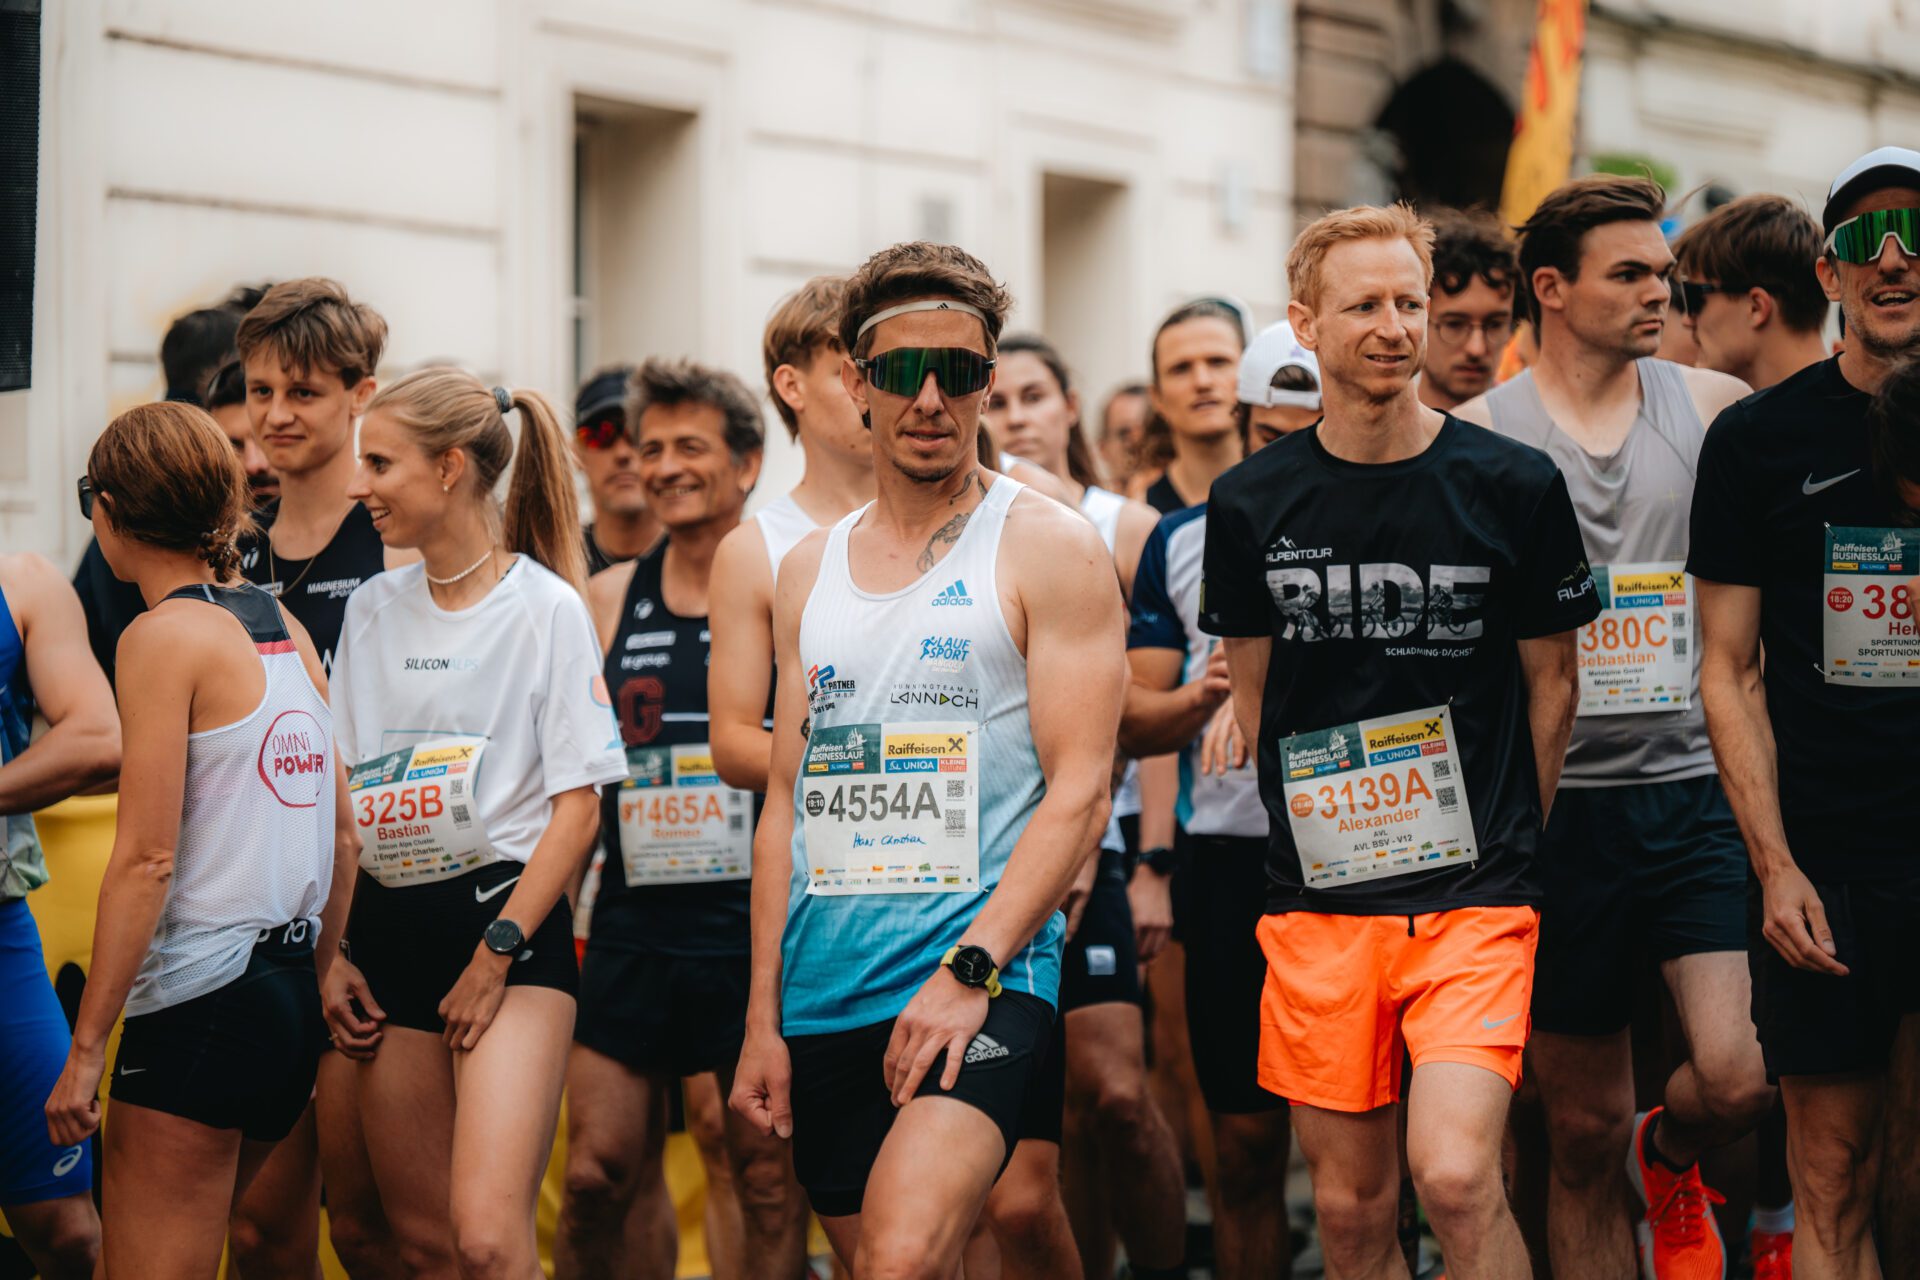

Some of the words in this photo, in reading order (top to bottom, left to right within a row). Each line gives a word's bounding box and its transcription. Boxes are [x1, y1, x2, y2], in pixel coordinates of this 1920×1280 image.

[1265, 547, 1333, 563] ALPENTOUR
[1833, 543, 1878, 553] Raiffeisen
[1832, 552, 1903, 561] BUSINESSLAUF
[307, 577, 361, 594] MAGNESIUM
[1617, 582, 1669, 593] Raiffeisen
[931, 597, 974, 607] adidas
[1266, 563, 1491, 642] RIDE
[1632, 596, 1660, 605] UNIQA
[1830, 595, 1852, 604] 18:20
[1580, 614, 1669, 652] 380C
[937, 636, 972, 650] LAUF
[929, 647, 970, 662] SPORT
[1578, 652, 1657, 668] Sebastian
[1858, 648, 1920, 657] SPORTUNION
[617, 676, 663, 746] G
[1369, 732, 1425, 749] Raiffeisen
[809, 751, 865, 762] BUSINESSLAUF
[812, 744, 843, 754] Raiffeisen
[888, 743, 946, 756] Raiffeisen
[1288, 747, 1328, 762] Raiffeisen
[1387, 748, 1418, 761] UNIQA
[903, 760, 935, 770] UNIQA
[1288, 750, 1349, 769] BUSINESSLAUF
[1318, 768, 1433, 820] 3139A
[358, 784, 444, 828] 325B
[807, 799, 824, 808] 19:10
[828, 782, 941, 822] 4554A
[634, 793, 724, 828] 1465A
[1338, 807, 1421, 834] Alexander
[377, 824, 431, 841] Bastian
[1373, 830, 1388, 838] AVL
[377, 841, 398, 851] Silicon
[399, 840, 412, 849] Alps
[413, 838, 436, 846] Cluster
[1353, 843, 1371, 852] AVL
[1372, 839, 1390, 849] BSV
[1397, 834, 1413, 844] V12
[380, 851, 399, 861] Engel
[400, 849, 411, 857] für
[412, 846, 445, 856] Charleen
[964, 1046, 1009, 1064] adidas
